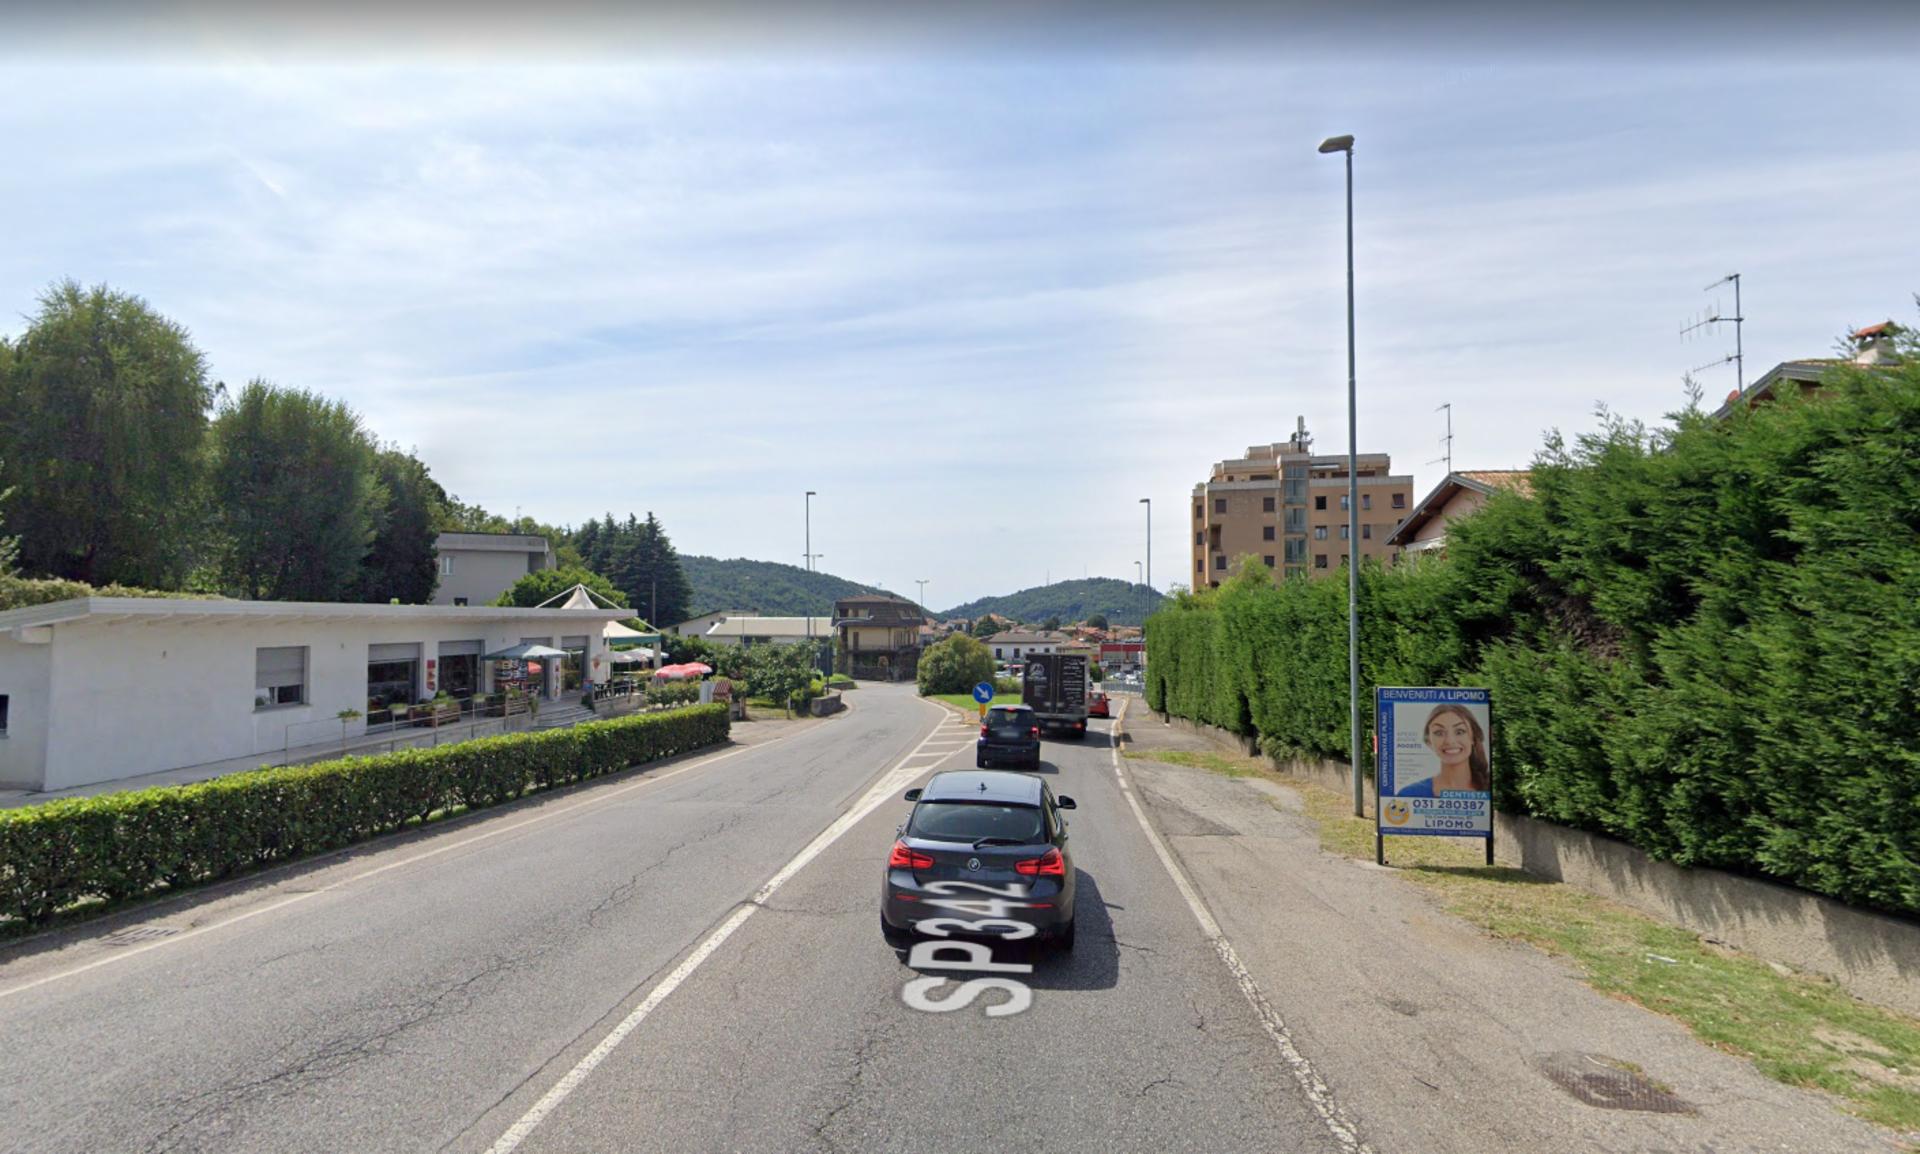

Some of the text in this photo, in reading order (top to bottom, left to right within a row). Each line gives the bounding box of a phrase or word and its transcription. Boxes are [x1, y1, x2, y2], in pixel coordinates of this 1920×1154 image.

[1383, 690, 1485, 700] BENVENUTI A LIPOMO
[1442, 791, 1487, 799] DENTISTA
[1412, 799, 1485, 810] 031 280387
[1425, 820, 1474, 829] LIPOMO
